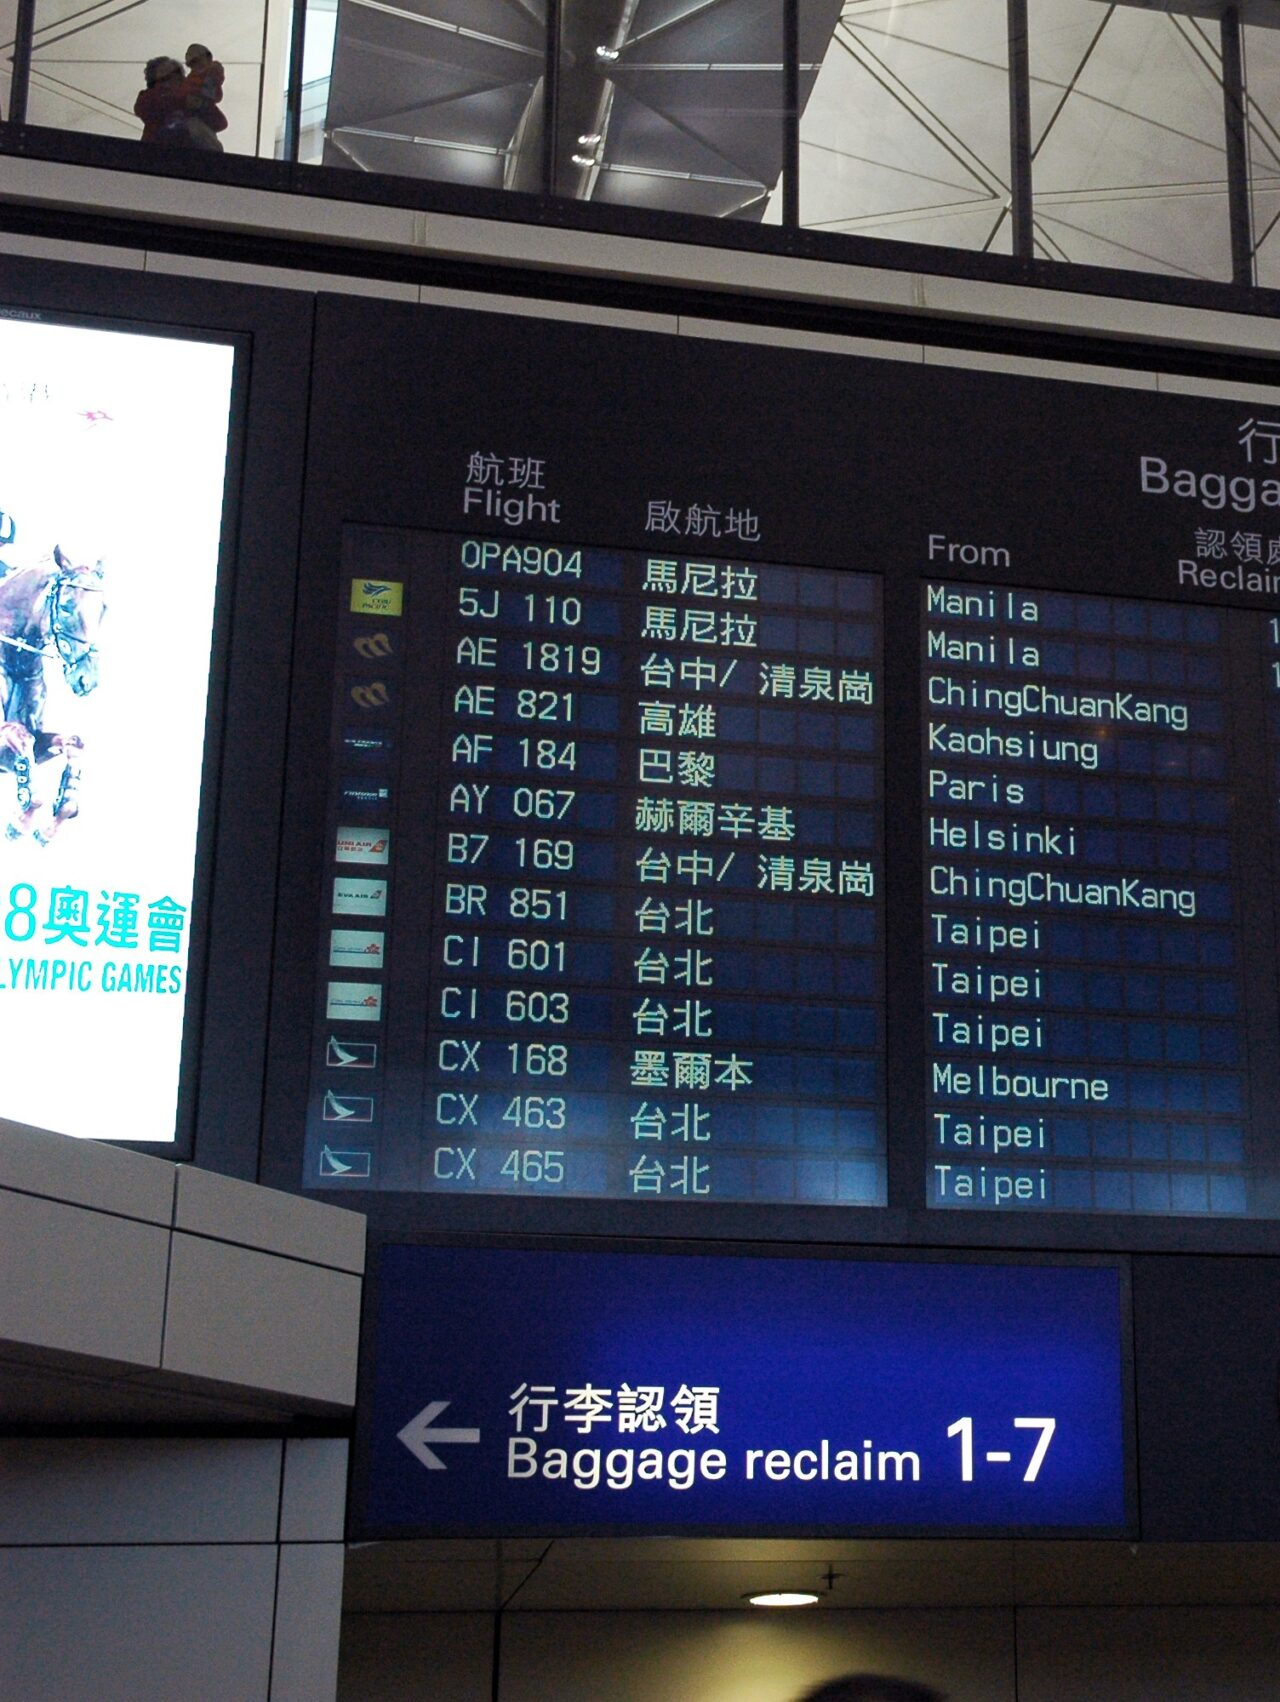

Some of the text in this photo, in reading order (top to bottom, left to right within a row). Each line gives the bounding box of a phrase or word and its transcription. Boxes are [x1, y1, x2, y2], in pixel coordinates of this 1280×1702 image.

[465, 451, 545, 490] 航班
[463, 487, 560, 525] Flight
[645, 500, 761, 542] 啟航地
[929, 534, 1010, 567] From
[642, 559, 758, 600] 馬尼拉
[459, 587, 581, 626] 5J 110
[927, 584, 1038, 621] Manila
[641, 606, 757, 647] 馬尼拉
[457, 637, 600, 675] AE 1819
[928, 630, 1039, 667] Manila
[454, 685, 572, 722] AE 821
[638, 700, 716, 738] 高雄
[928, 676, 1188, 731] ChingChuanKang
[452, 734, 576, 771] AF 184
[929, 722, 1098, 770] Kaohsiung
[639, 748, 715, 787] 巴黎
[929, 769, 1024, 804] Paris
[450, 783, 575, 820] AY 067
[635, 796, 795, 841] 赫爾辛基
[448, 833, 573, 870] B7 169
[930, 817, 1075, 855] Helsinki
[445, 883, 566, 920] BR 851
[930, 865, 1196, 917] ChingChuanKang
[635, 897, 713, 935] 台北
[931, 914, 1039, 953] Taipei
[443, 935, 565, 972] CI 601
[634, 947, 713, 986] 台北
[0, 958, 182, 994] YMPIC GAMES
[932, 962, 1040, 1002] Taipei
[441, 987, 569, 1024] CI 603
[632, 997, 712, 1037] 台北
[932, 1012, 1042, 1052] Taipei
[439, 1039, 567, 1076] CX 168
[630, 1050, 753, 1091] 墨爾本
[933, 1062, 1109, 1101] Melbourne
[436, 1093, 565, 1129] CX 463
[630, 1102, 711, 1141] 台北
[934, 1113, 1044, 1153] Taipei
[434, 1147, 564, 1182] CX 465
[629, 1155, 710, 1194] 台北
[934, 1165, 1045, 1204] Taipei
[509, 1382, 720, 1435] 行李認領
[508, 1417, 1056, 1490] Baggage reclaim 1-7
